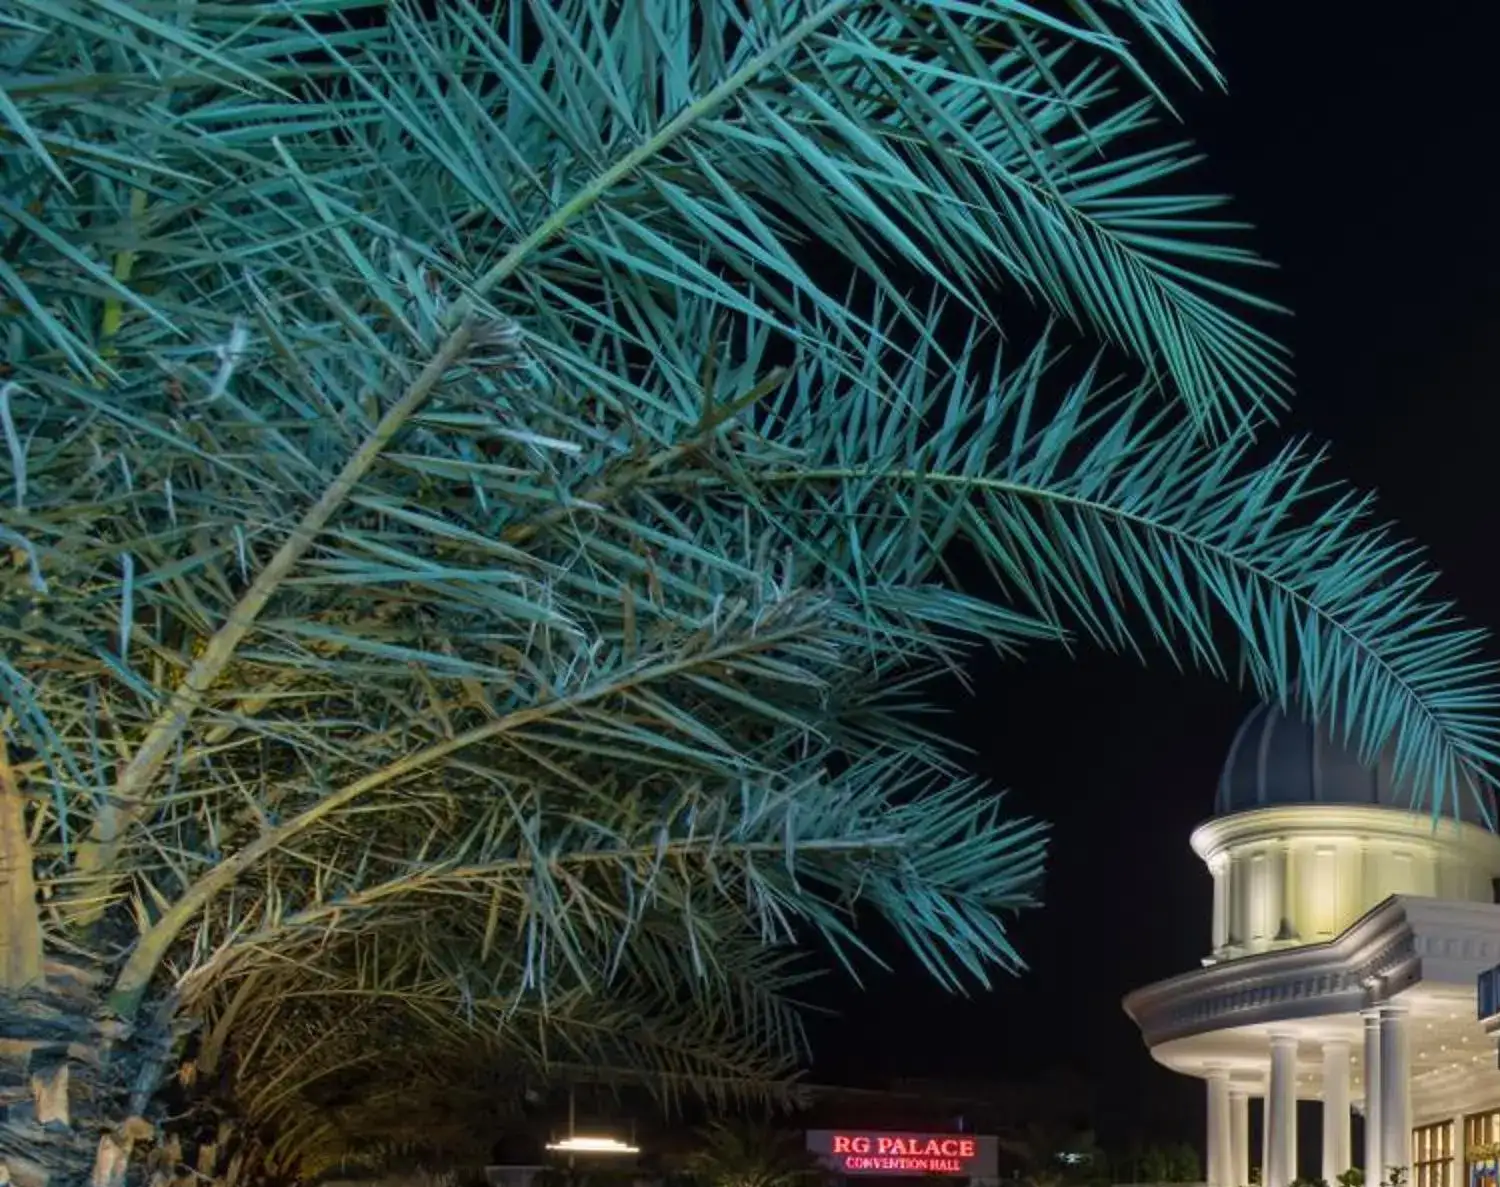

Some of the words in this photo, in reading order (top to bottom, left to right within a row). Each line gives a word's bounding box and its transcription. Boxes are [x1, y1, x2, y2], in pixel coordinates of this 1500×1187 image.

[833, 1136, 869, 1153] RG
[878, 1137, 975, 1157] PALACE
[846, 1156, 928, 1170] CONVENTION
[930, 1158, 961, 1171] HALL
